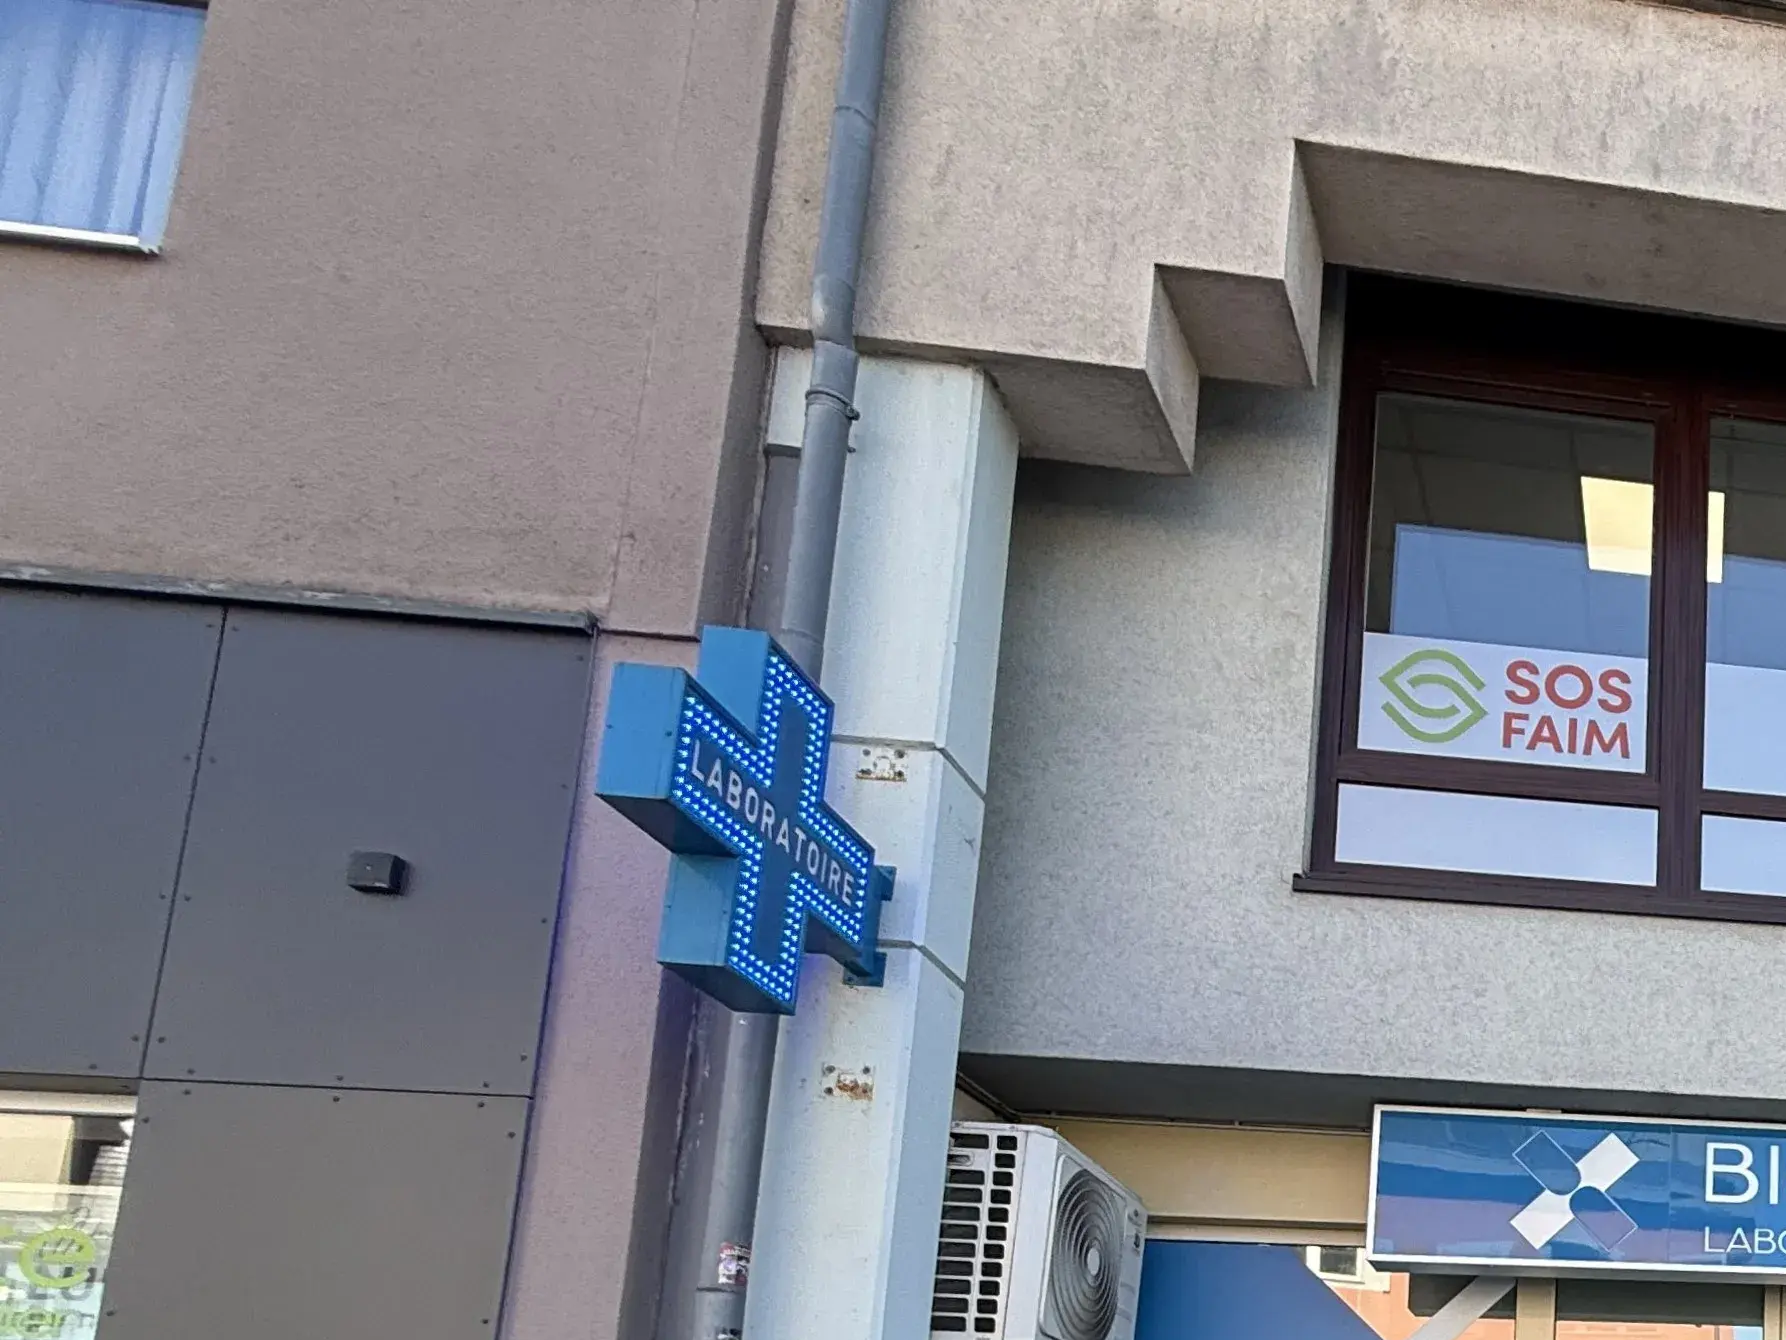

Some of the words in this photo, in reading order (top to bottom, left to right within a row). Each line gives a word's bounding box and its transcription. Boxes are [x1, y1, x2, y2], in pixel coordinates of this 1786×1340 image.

[1504, 659, 1633, 714] SOS
[1502, 711, 1631, 760] FAIM
[691, 739, 854, 906] LABORATOIRE
